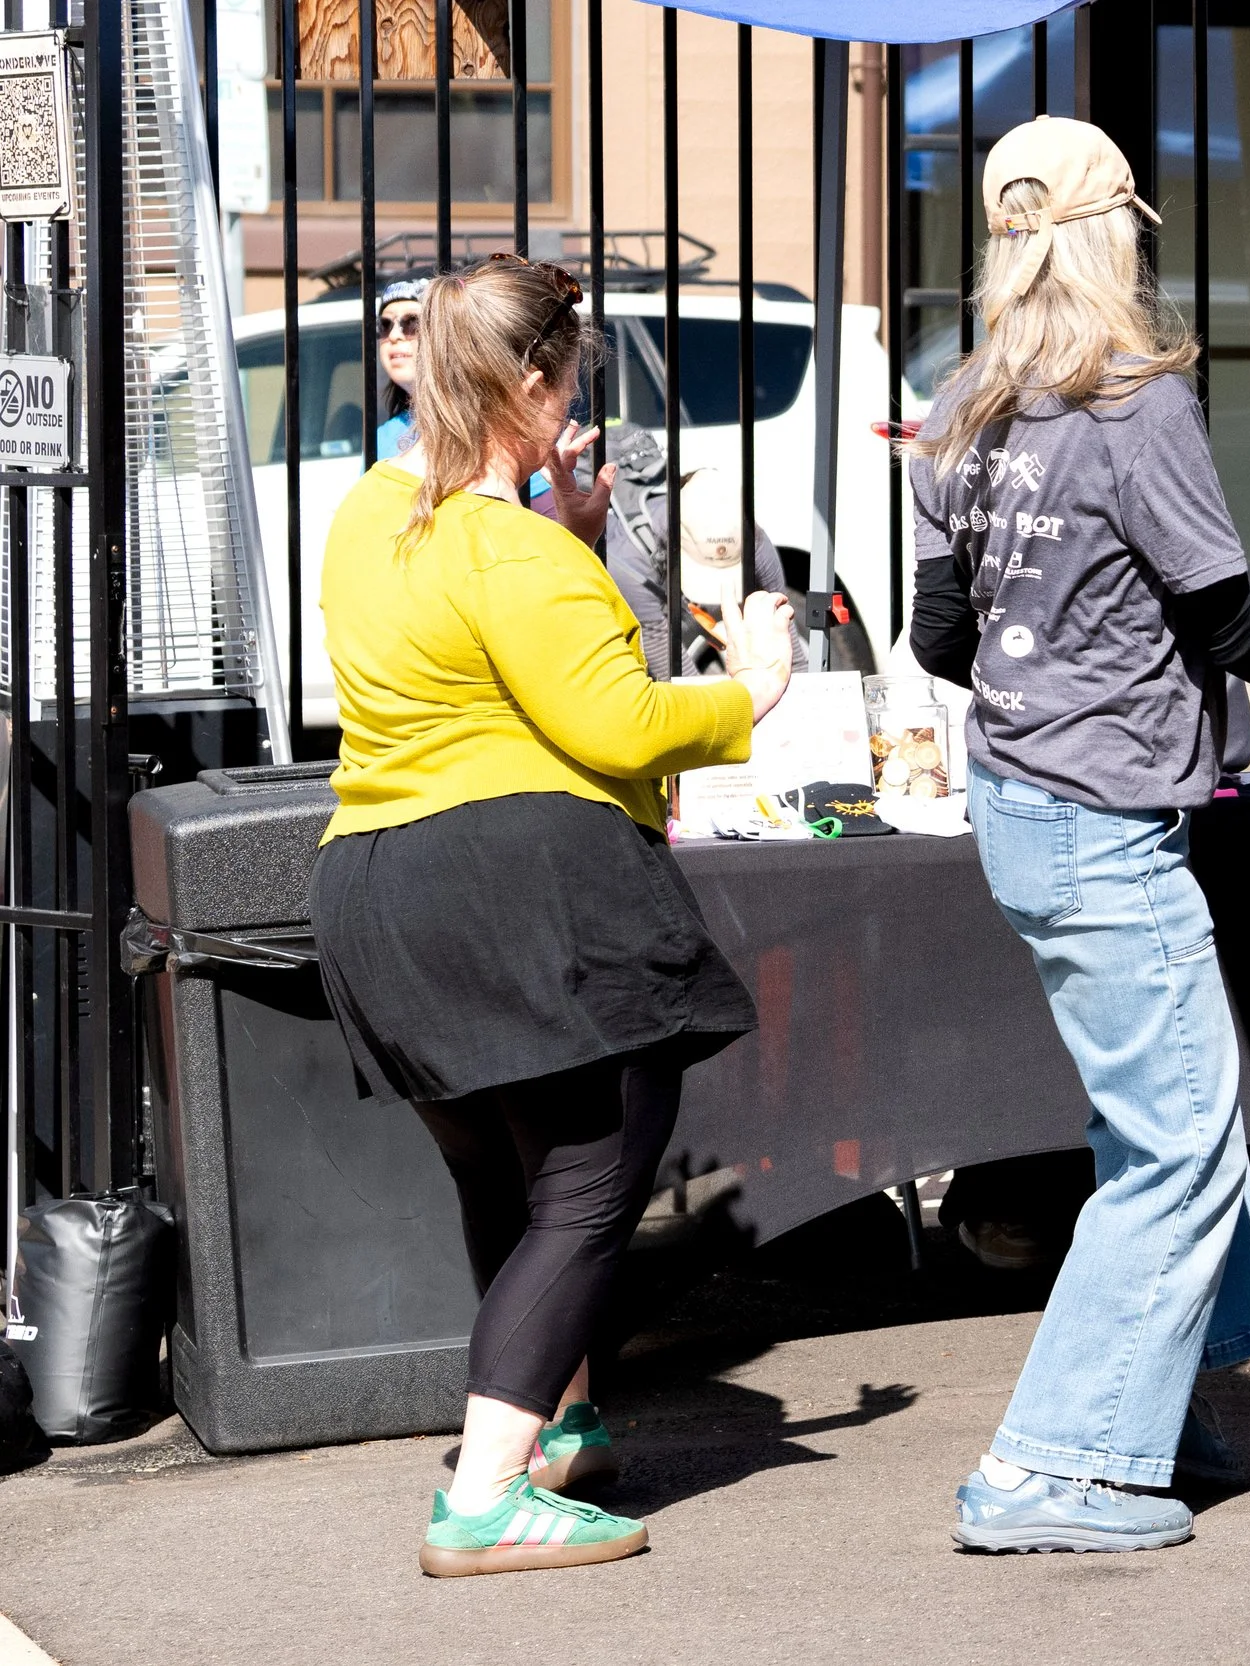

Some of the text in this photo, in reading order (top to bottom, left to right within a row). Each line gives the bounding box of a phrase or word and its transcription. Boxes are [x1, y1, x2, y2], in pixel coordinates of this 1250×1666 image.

[33, 191, 60, 201] EVENTS
[26, 375, 54, 409] NO
[26, 412, 63, 428] OUTSIDE
[0, 439, 62, 457] OOD OR DRINK
[963, 463, 981, 476] PGF
